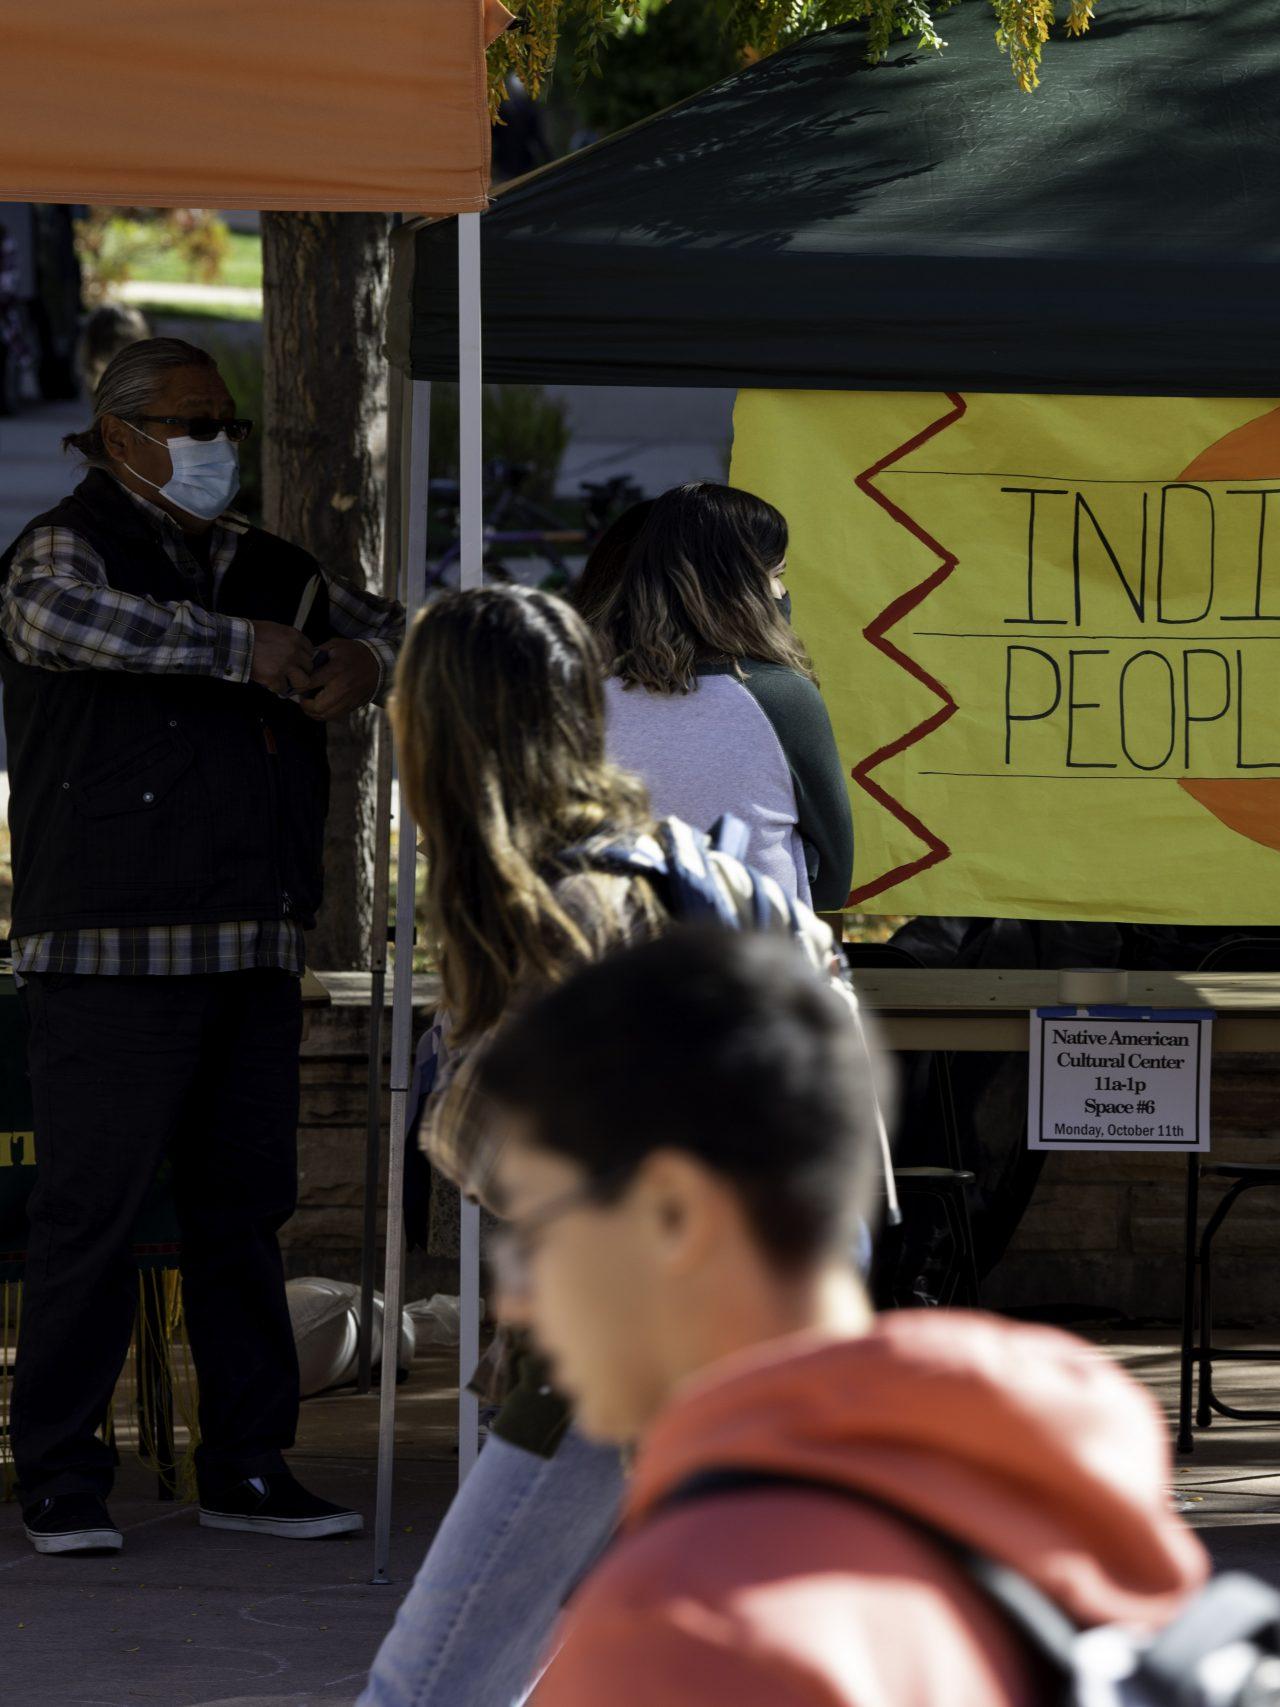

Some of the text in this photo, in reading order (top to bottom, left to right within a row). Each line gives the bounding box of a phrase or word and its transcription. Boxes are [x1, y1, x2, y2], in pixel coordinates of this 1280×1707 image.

[1053, 1030, 1190, 1046] Native American
[1057, 1052, 1185, 1069] Cultural Center
[1095, 1076, 1146, 1095] 11a-1p
[1084, 1098, 1155, 1117] Space #6
[1054, 1123, 1184, 1138] Monday, October 11th
